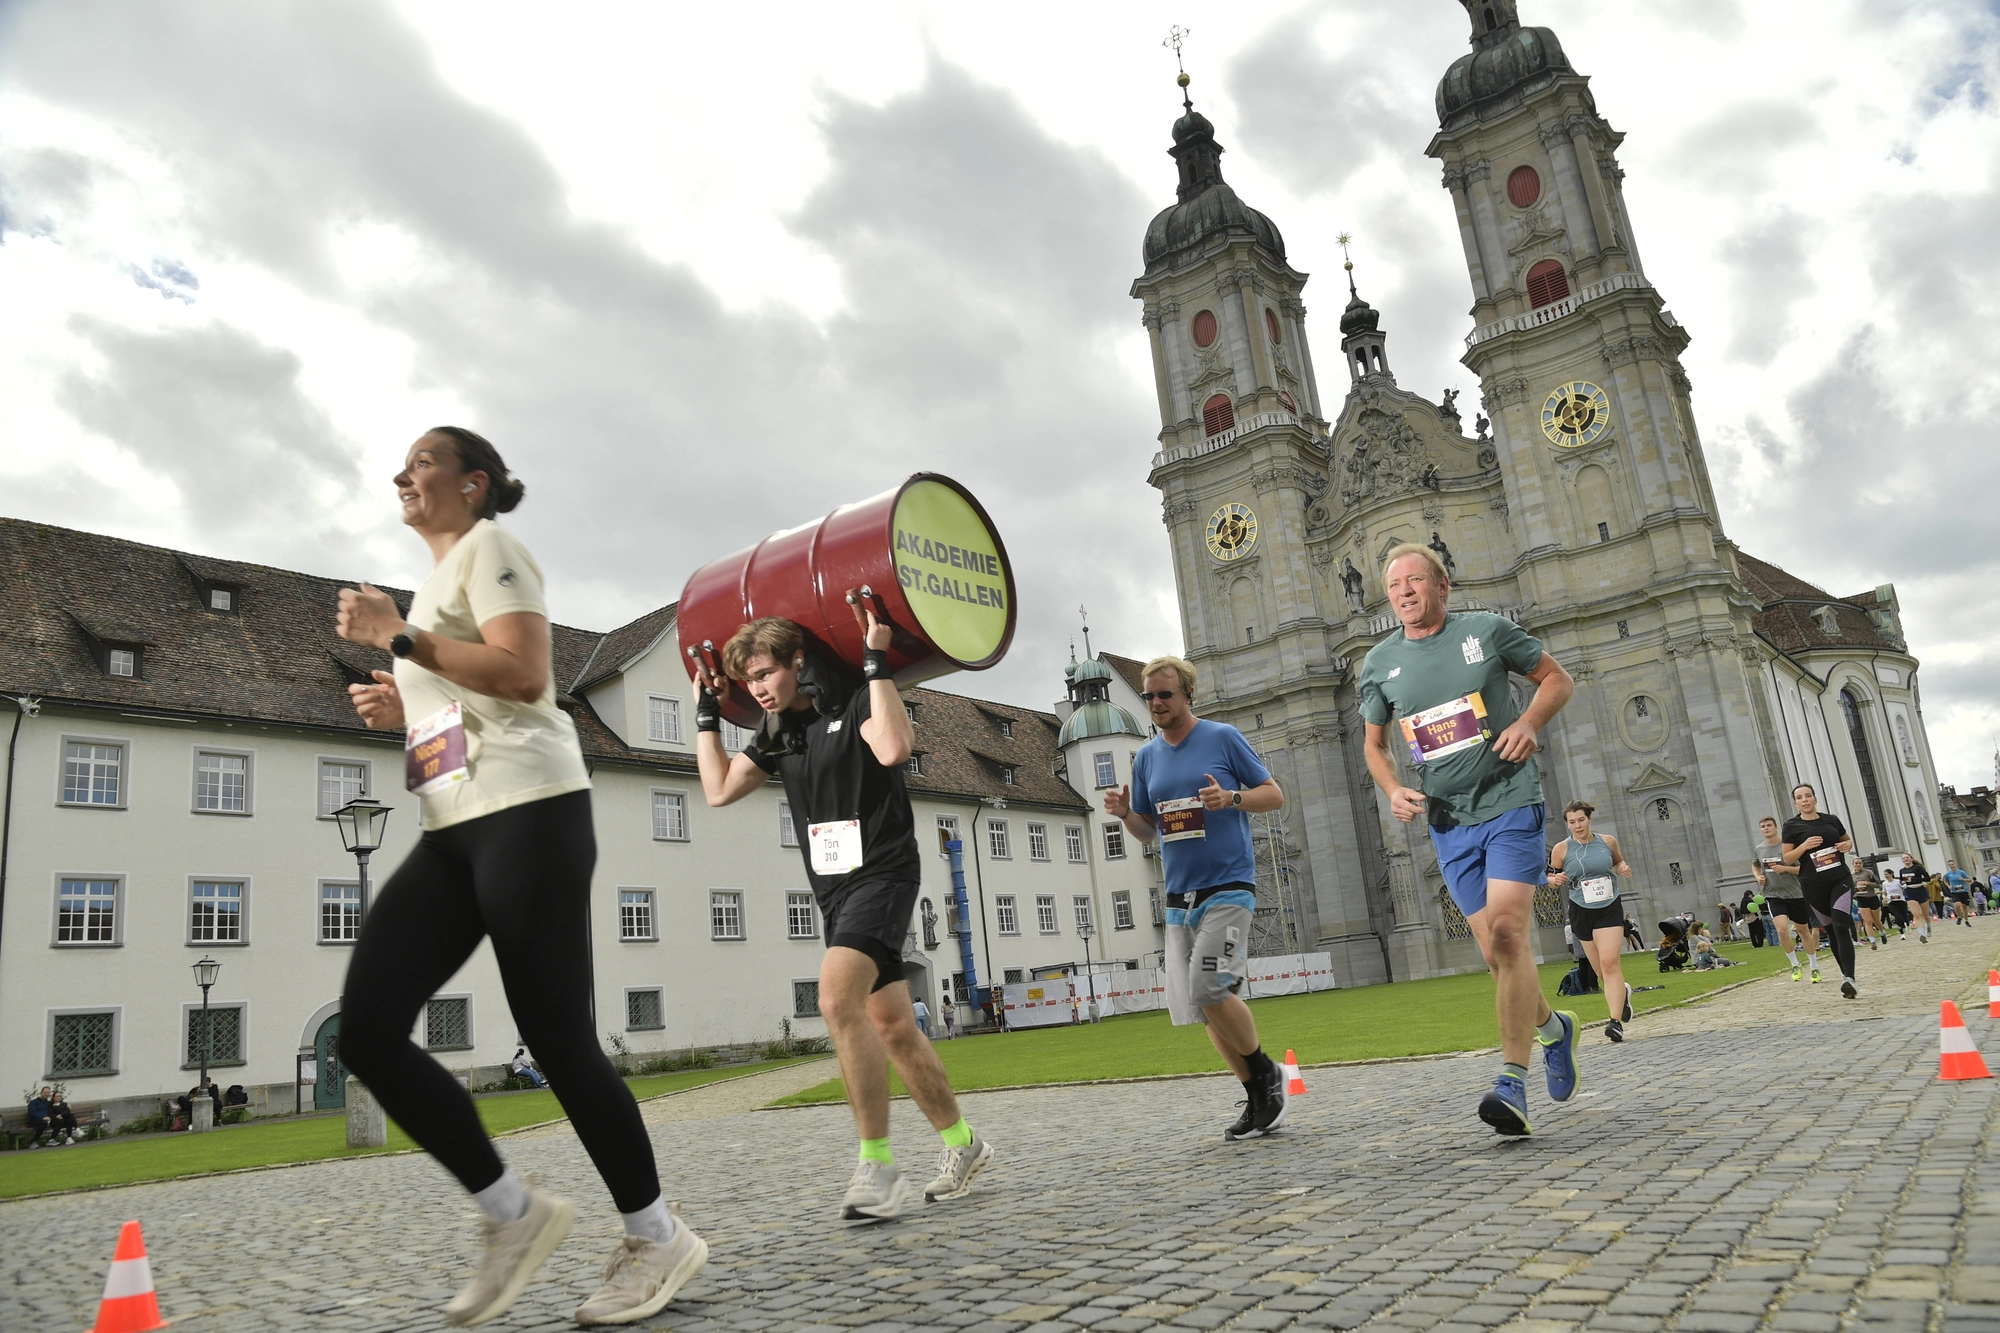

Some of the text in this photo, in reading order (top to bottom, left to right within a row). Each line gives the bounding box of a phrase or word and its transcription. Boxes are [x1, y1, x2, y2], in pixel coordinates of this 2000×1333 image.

[897, 529, 999, 576] AKADEMIE
[900, 564, 1004, 610] ST.GALLEN
[1462, 634, 1480, 652] AUF
[1465, 653, 1484, 664] LAUF
[1426, 719, 1457, 736] Hans
[1436, 731, 1454, 744] 117
[1164, 811, 1192, 822] Steffen
[825, 852, 838, 862] 310
